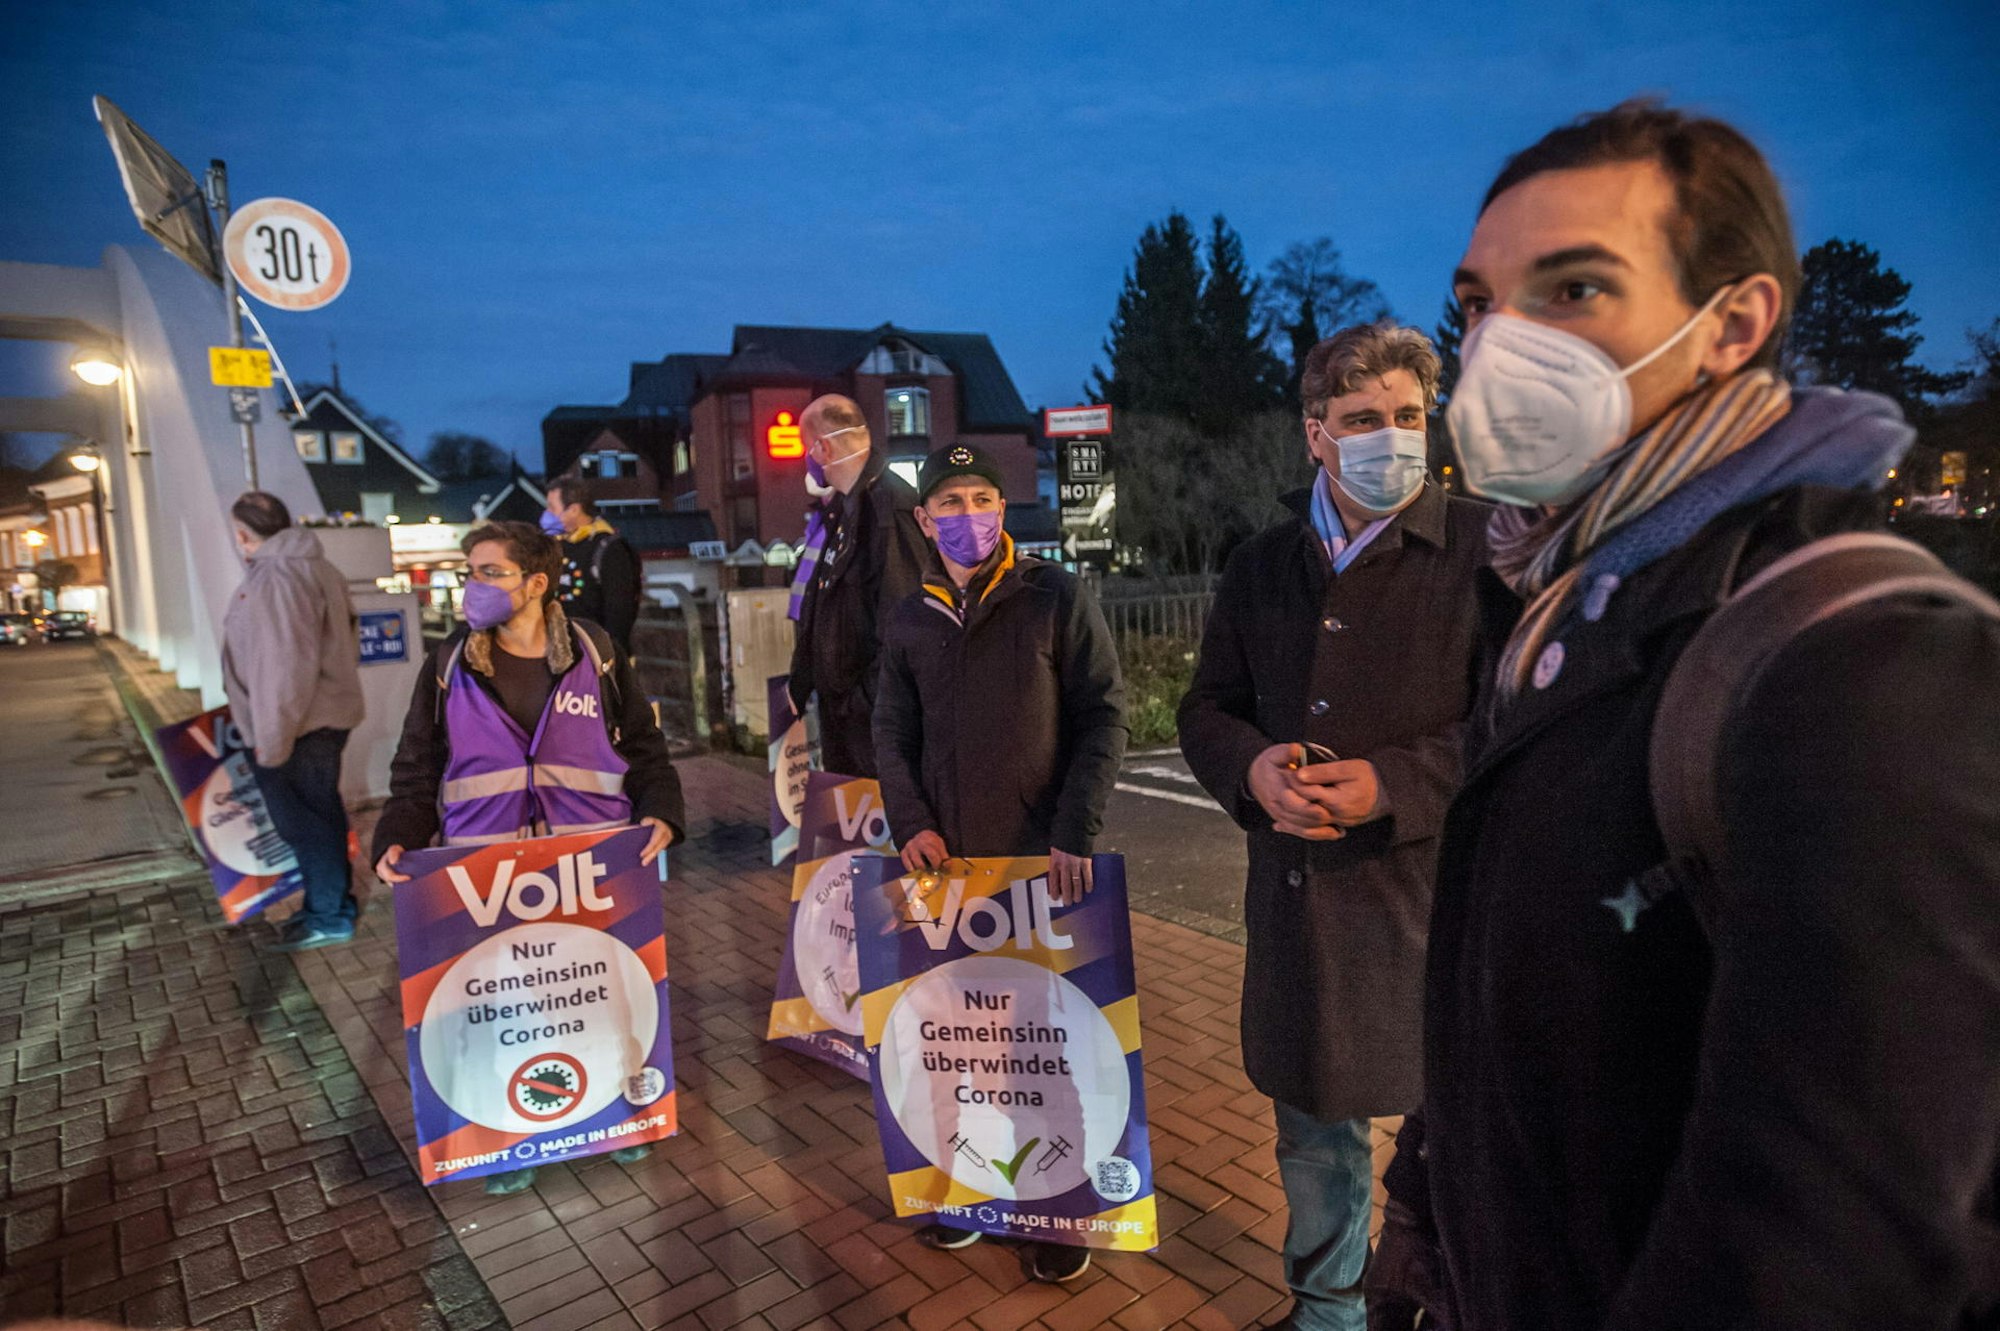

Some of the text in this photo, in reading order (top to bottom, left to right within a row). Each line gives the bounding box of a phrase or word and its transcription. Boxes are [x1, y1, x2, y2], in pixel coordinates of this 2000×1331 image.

[256, 225, 320, 284] 30 t
[1060, 483, 1102, 500] HOTE
[554, 690, 599, 719] Volt
[187, 715, 245, 759] Vo
[834, 787, 892, 848] Vo
[446, 850, 615, 928] Volt
[900, 878, 1075, 951] Volt
[828, 919, 857, 945] Imp
[512, 941, 557, 961] Nur
[465, 961, 607, 997] Gemeinsinn
[468, 985, 608, 1025] überwindet
[963, 990, 1011, 1010] Nur
[500, 1019, 585, 1046] Corona
[920, 1020, 1068, 1043] Gemeinsinn
[923, 1051, 1070, 1075] überwindet
[954, 1085, 1044, 1107] Corona
[434, 1150, 511, 1172] ZUKUNFT
[540, 1133, 587, 1154] MADE
[588, 1128, 606, 1143] IN
[608, 1114, 667, 1139] EUROPE
[904, 1196, 1144, 1235] ZUKUNFT MADE IN EUROPE
